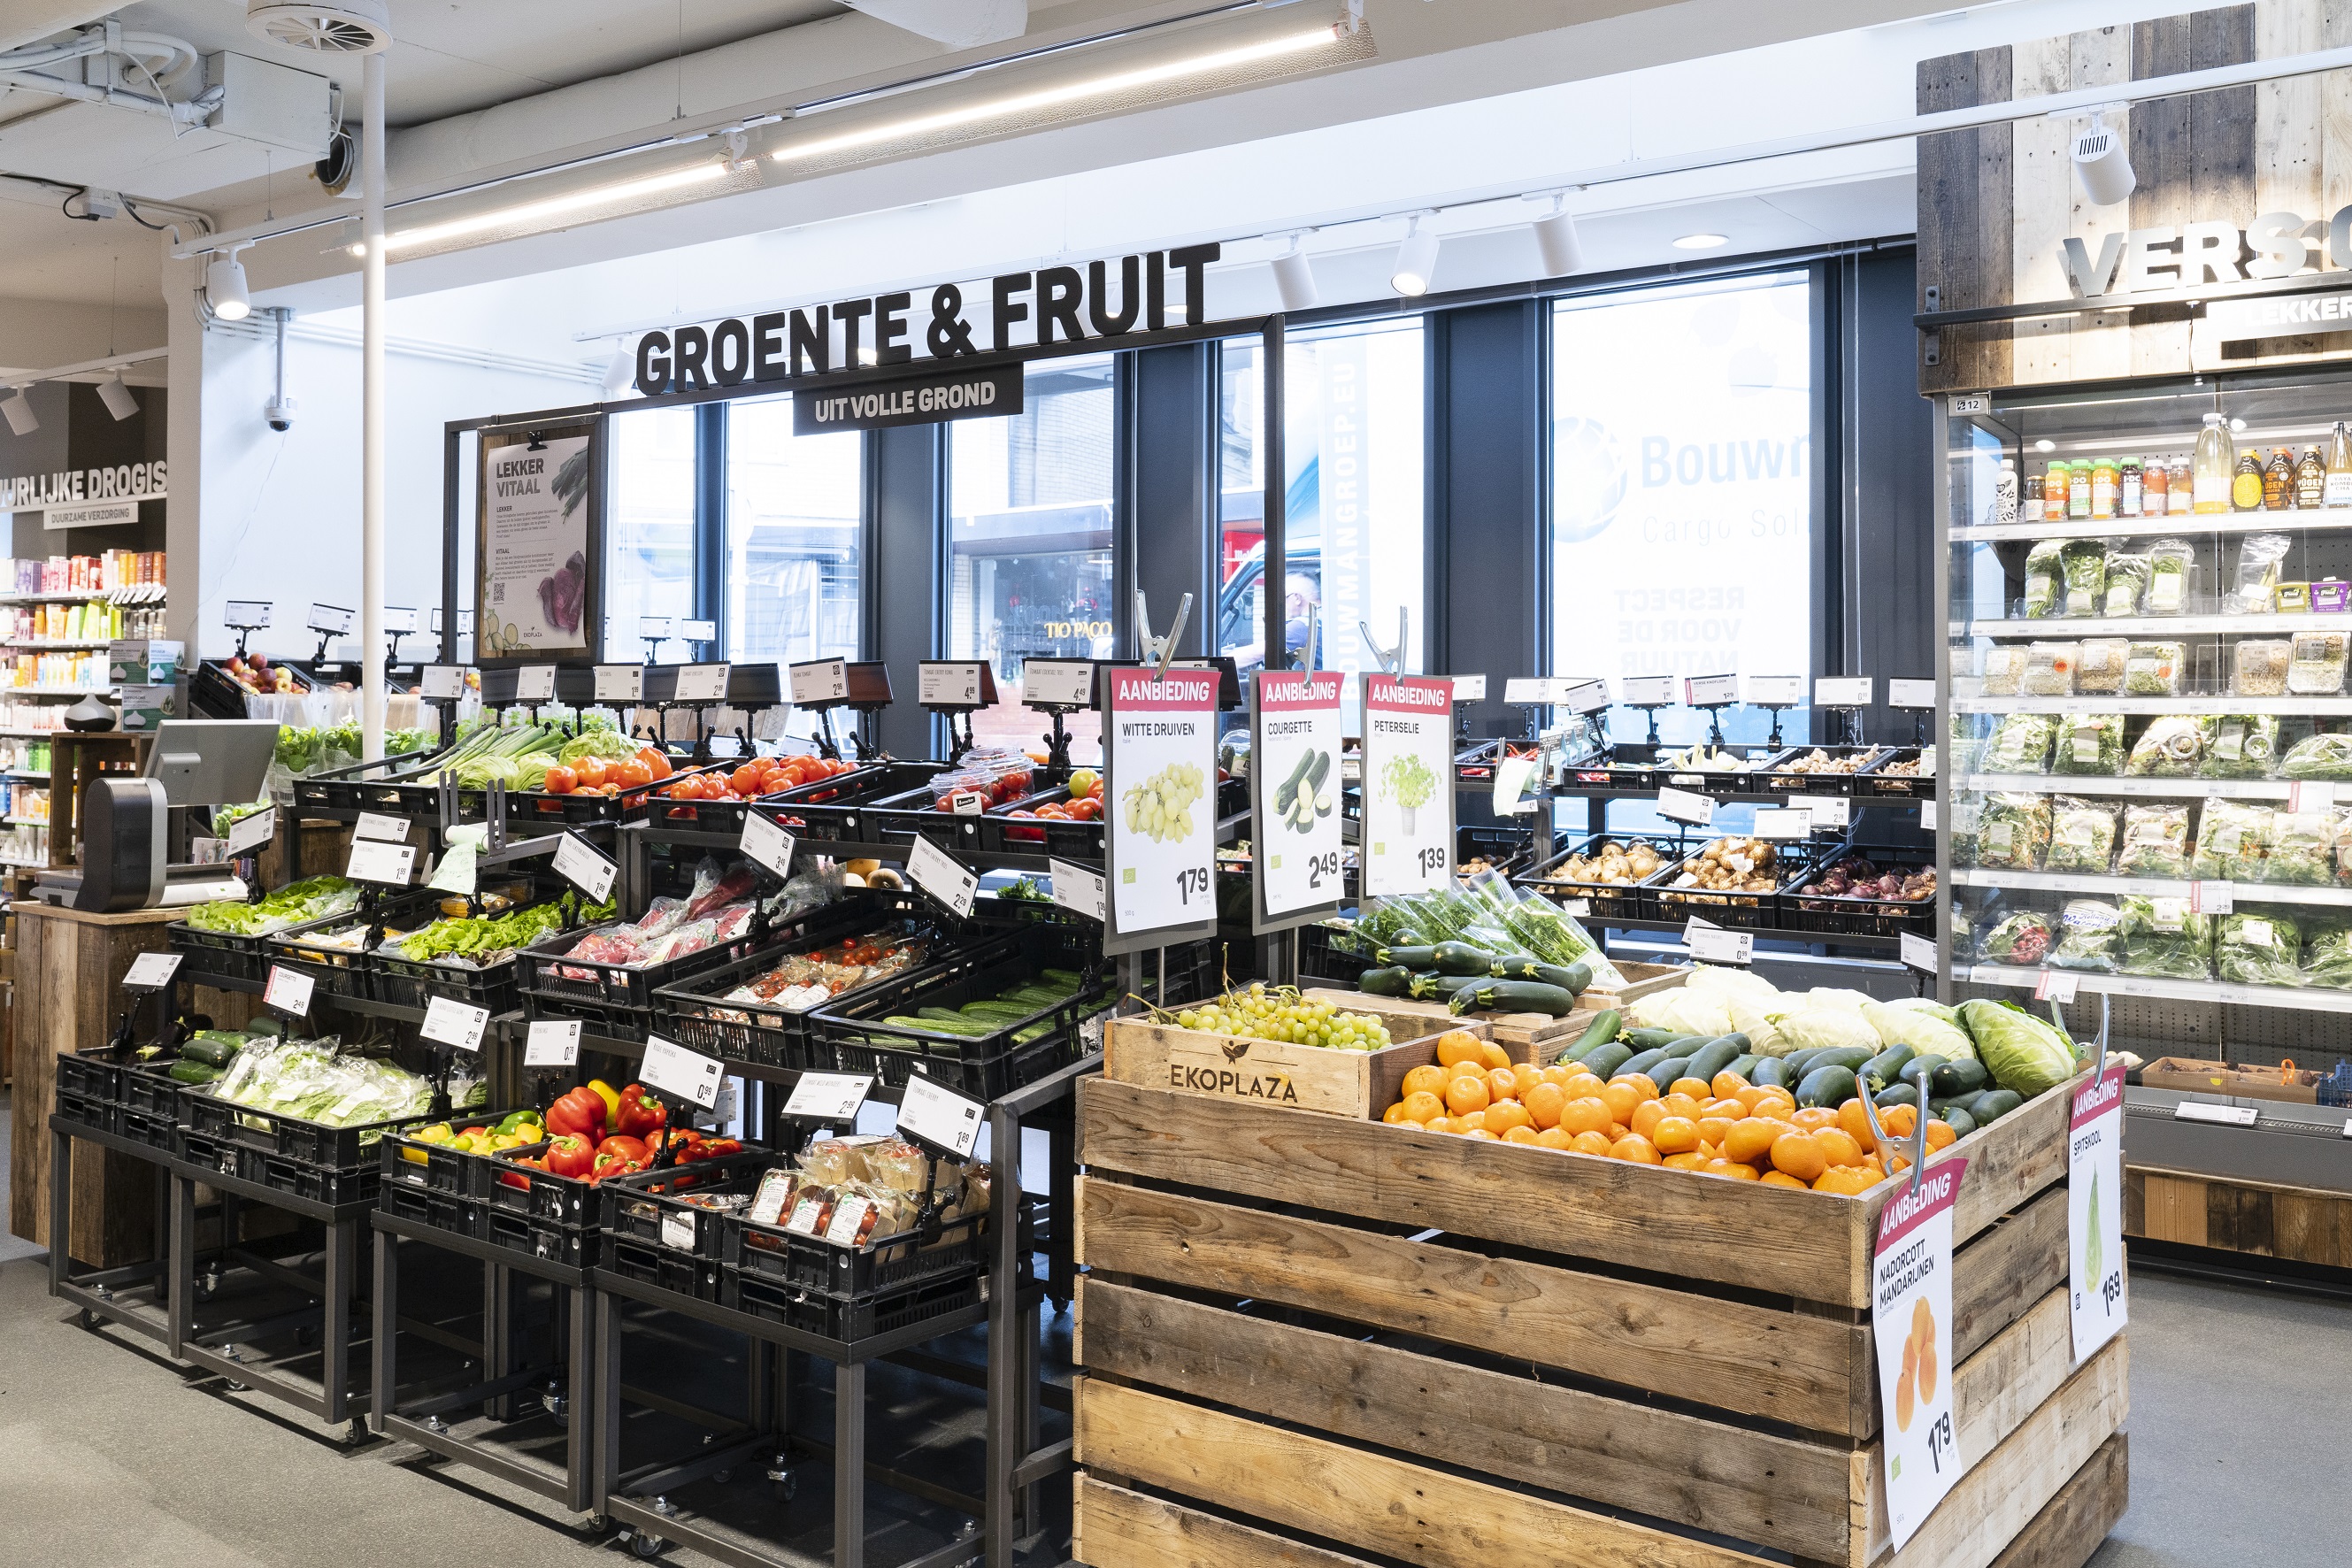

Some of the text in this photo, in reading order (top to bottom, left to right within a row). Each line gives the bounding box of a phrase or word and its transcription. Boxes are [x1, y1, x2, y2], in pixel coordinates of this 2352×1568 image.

[636, 242, 1221, 396] GROENTE & FRUIT
[815, 381, 995, 422] UIT VOLLE GROND
[88, 460, 167, 499] DROGIS
[496, 458, 544, 478] LEKKER
[496, 479, 541, 497] VITAAL
[51, 508, 130, 524] DUURZAME VERZORGING
[1333, 363, 1360, 701] BOUWMANGROEP.EU
[1643, 516, 1731, 547] Cargo
[1044, 621, 1113, 642] TIO PACO
[965, 687, 975, 699] 4.99
[1072, 688, 1086, 701] 4.49
[1118, 680, 1211, 702] AANBIEDING
[1265, 681, 1336, 703] AANBIEDING
[1372, 684, 1445, 707] AANBIEDING
[1122, 723, 1195, 736] WITTE DRUIVEN
[1268, 721, 1312, 735] COURGETTE
[1374, 720, 1419, 734] PETERSELIE
[1309, 851, 1338, 888] 249
[1418, 847, 1445, 878] 139
[1176, 867, 1209, 905] 179
[953, 893, 967, 910] 2.29
[697, 1084, 711, 1101] 0.99
[913, 1084, 939, 1103] TOMAAT CHERRY
[1170, 1064, 1298, 1103] EKOPLAZA
[838, 1100, 855, 1115] 2.99
[2073, 1077, 2118, 1119] AANBIEDING
[957, 1131, 970, 1149] 1.89
[2073, 1129, 2102, 1157] SPITSKOOL
[1880, 1172, 1951, 1241] AANBIEDING
[1880, 1238, 1925, 1287] NADORCOTT
[1880, 1254, 1934, 1310] MANDARIJNEN
[2102, 1270, 2120, 1318] 169
[1928, 1410, 1951, 1474] 179
